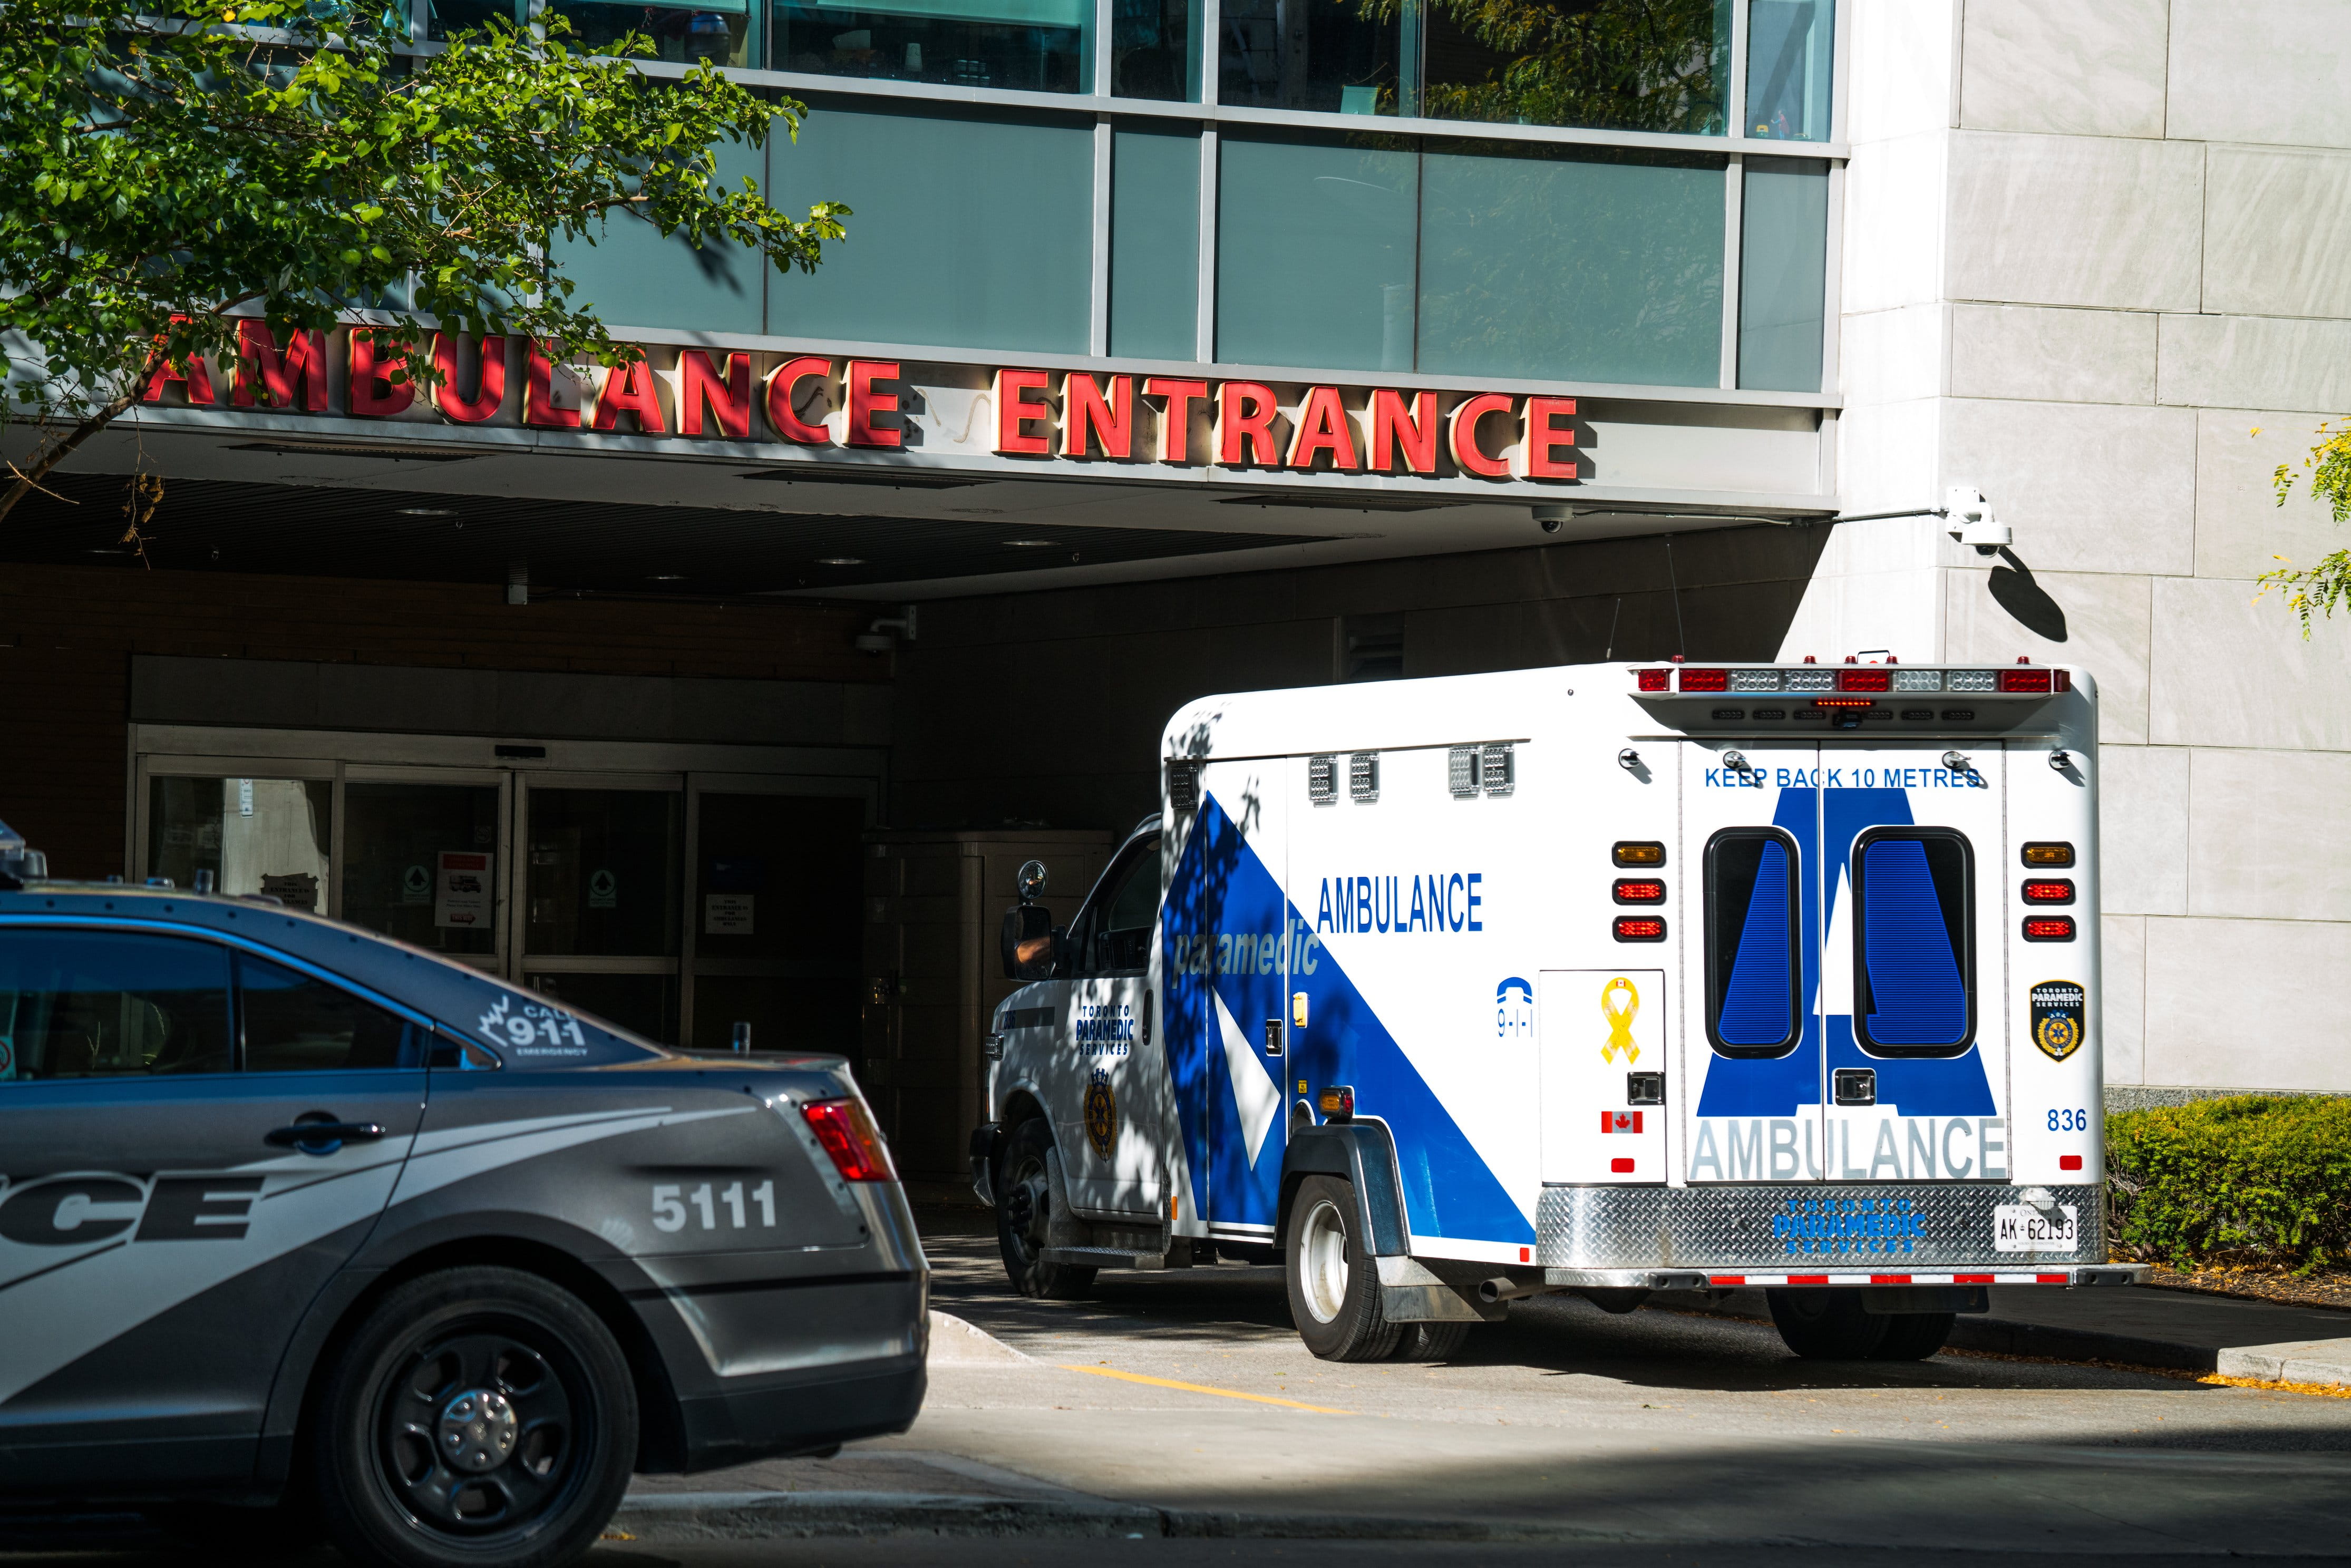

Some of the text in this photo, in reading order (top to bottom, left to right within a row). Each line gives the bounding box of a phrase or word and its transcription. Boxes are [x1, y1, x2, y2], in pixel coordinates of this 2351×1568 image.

[142, 314, 1577, 479] AMBULANCE ENTRANCE
[1706, 768, 1981, 788] KEEP BACK 10 METRES
[1317, 873, 1483, 933] AMBULANCE
[1172, 919, 1319, 989] paramedic
[2032, 993, 2083, 1001] PARAMEDIC
[1004, 1010, 1016, 1030] 836
[1083, 1005, 1129, 1017] TORONTO
[507, 1016, 586, 1046] 9-1-1
[1076, 1019, 1134, 1041] PARAMEDIC
[516, 1047, 589, 1056] EMERGENCY
[1080, 1043, 1128, 1056] SERVICES
[2048, 1108, 2087, 1132] 836
[1689, 1118, 2005, 1180] AMBULANCE
[653, 1180, 776, 1233] 5111
[1786, 1199, 1912, 1212] TORONTO
[1773, 1214, 1927, 1238] PARAMEDIC
[2000, 1219, 2073, 1240] AK 62193
[1786, 1239, 1914, 1254] SERVICES
